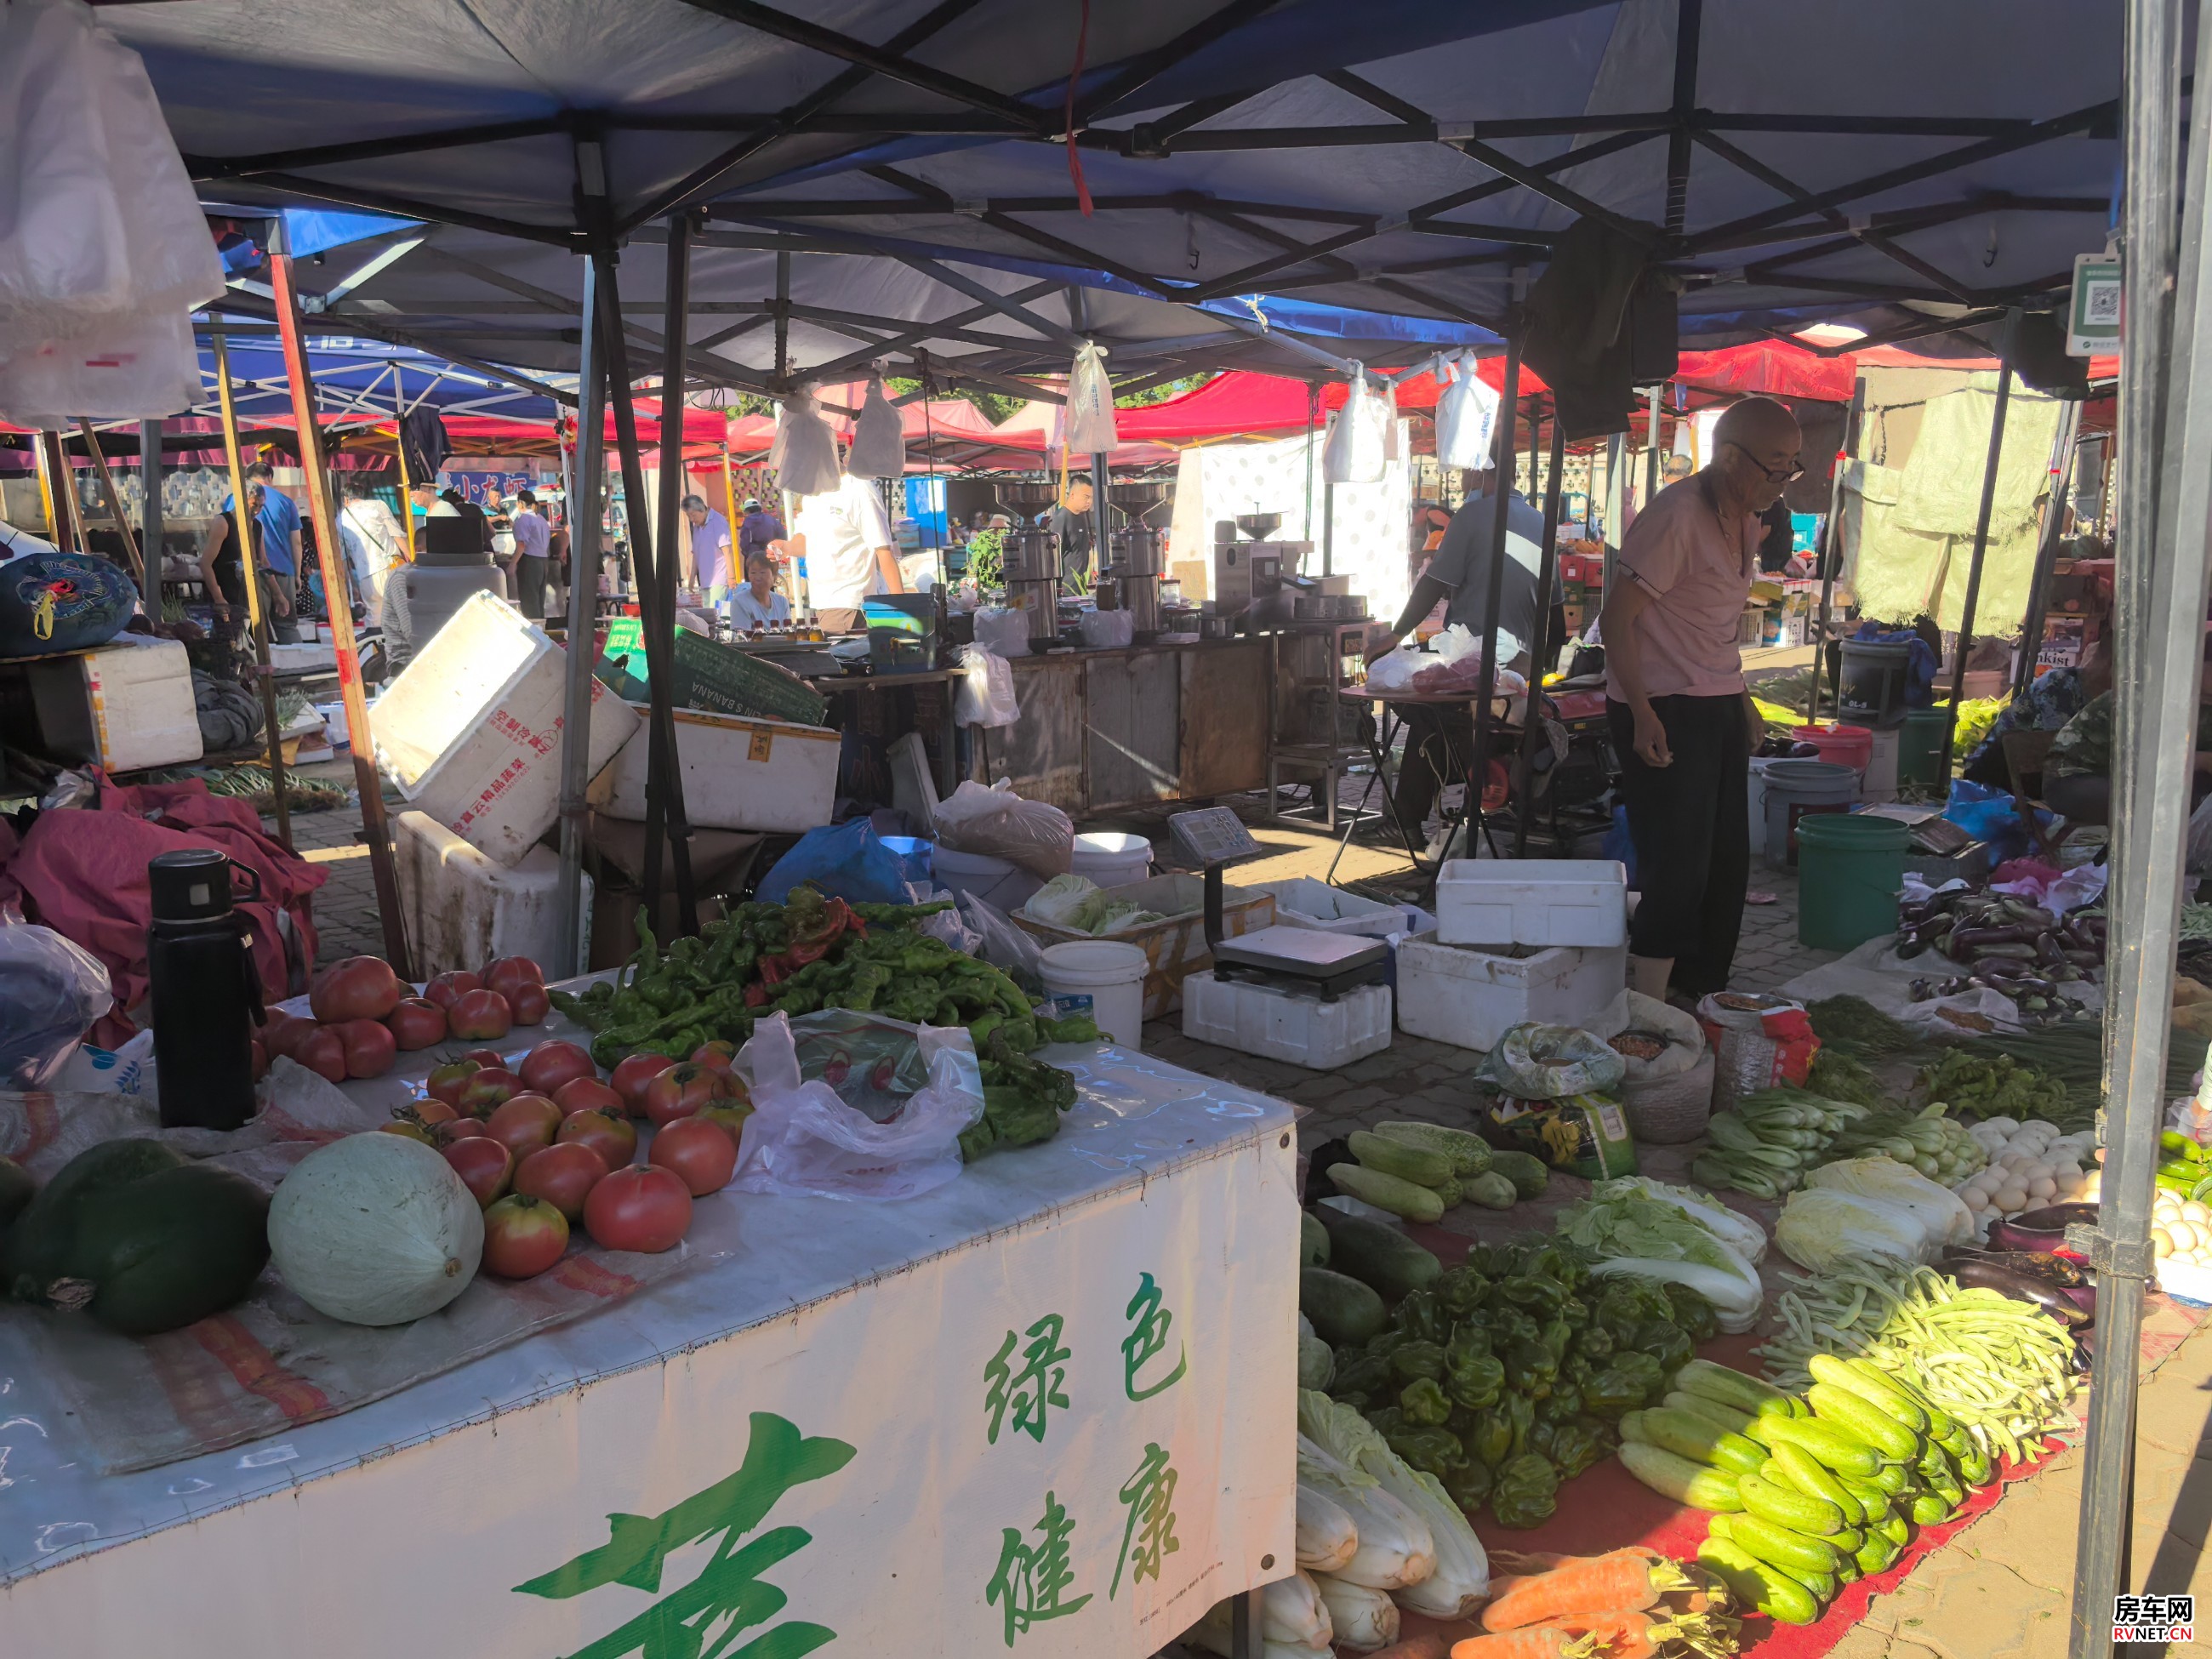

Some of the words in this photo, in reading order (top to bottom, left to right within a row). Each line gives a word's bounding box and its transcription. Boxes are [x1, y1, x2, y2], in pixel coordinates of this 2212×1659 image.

[445, 471, 527, 505] 小龙虾
[692, 681, 736, 710] BANANA
